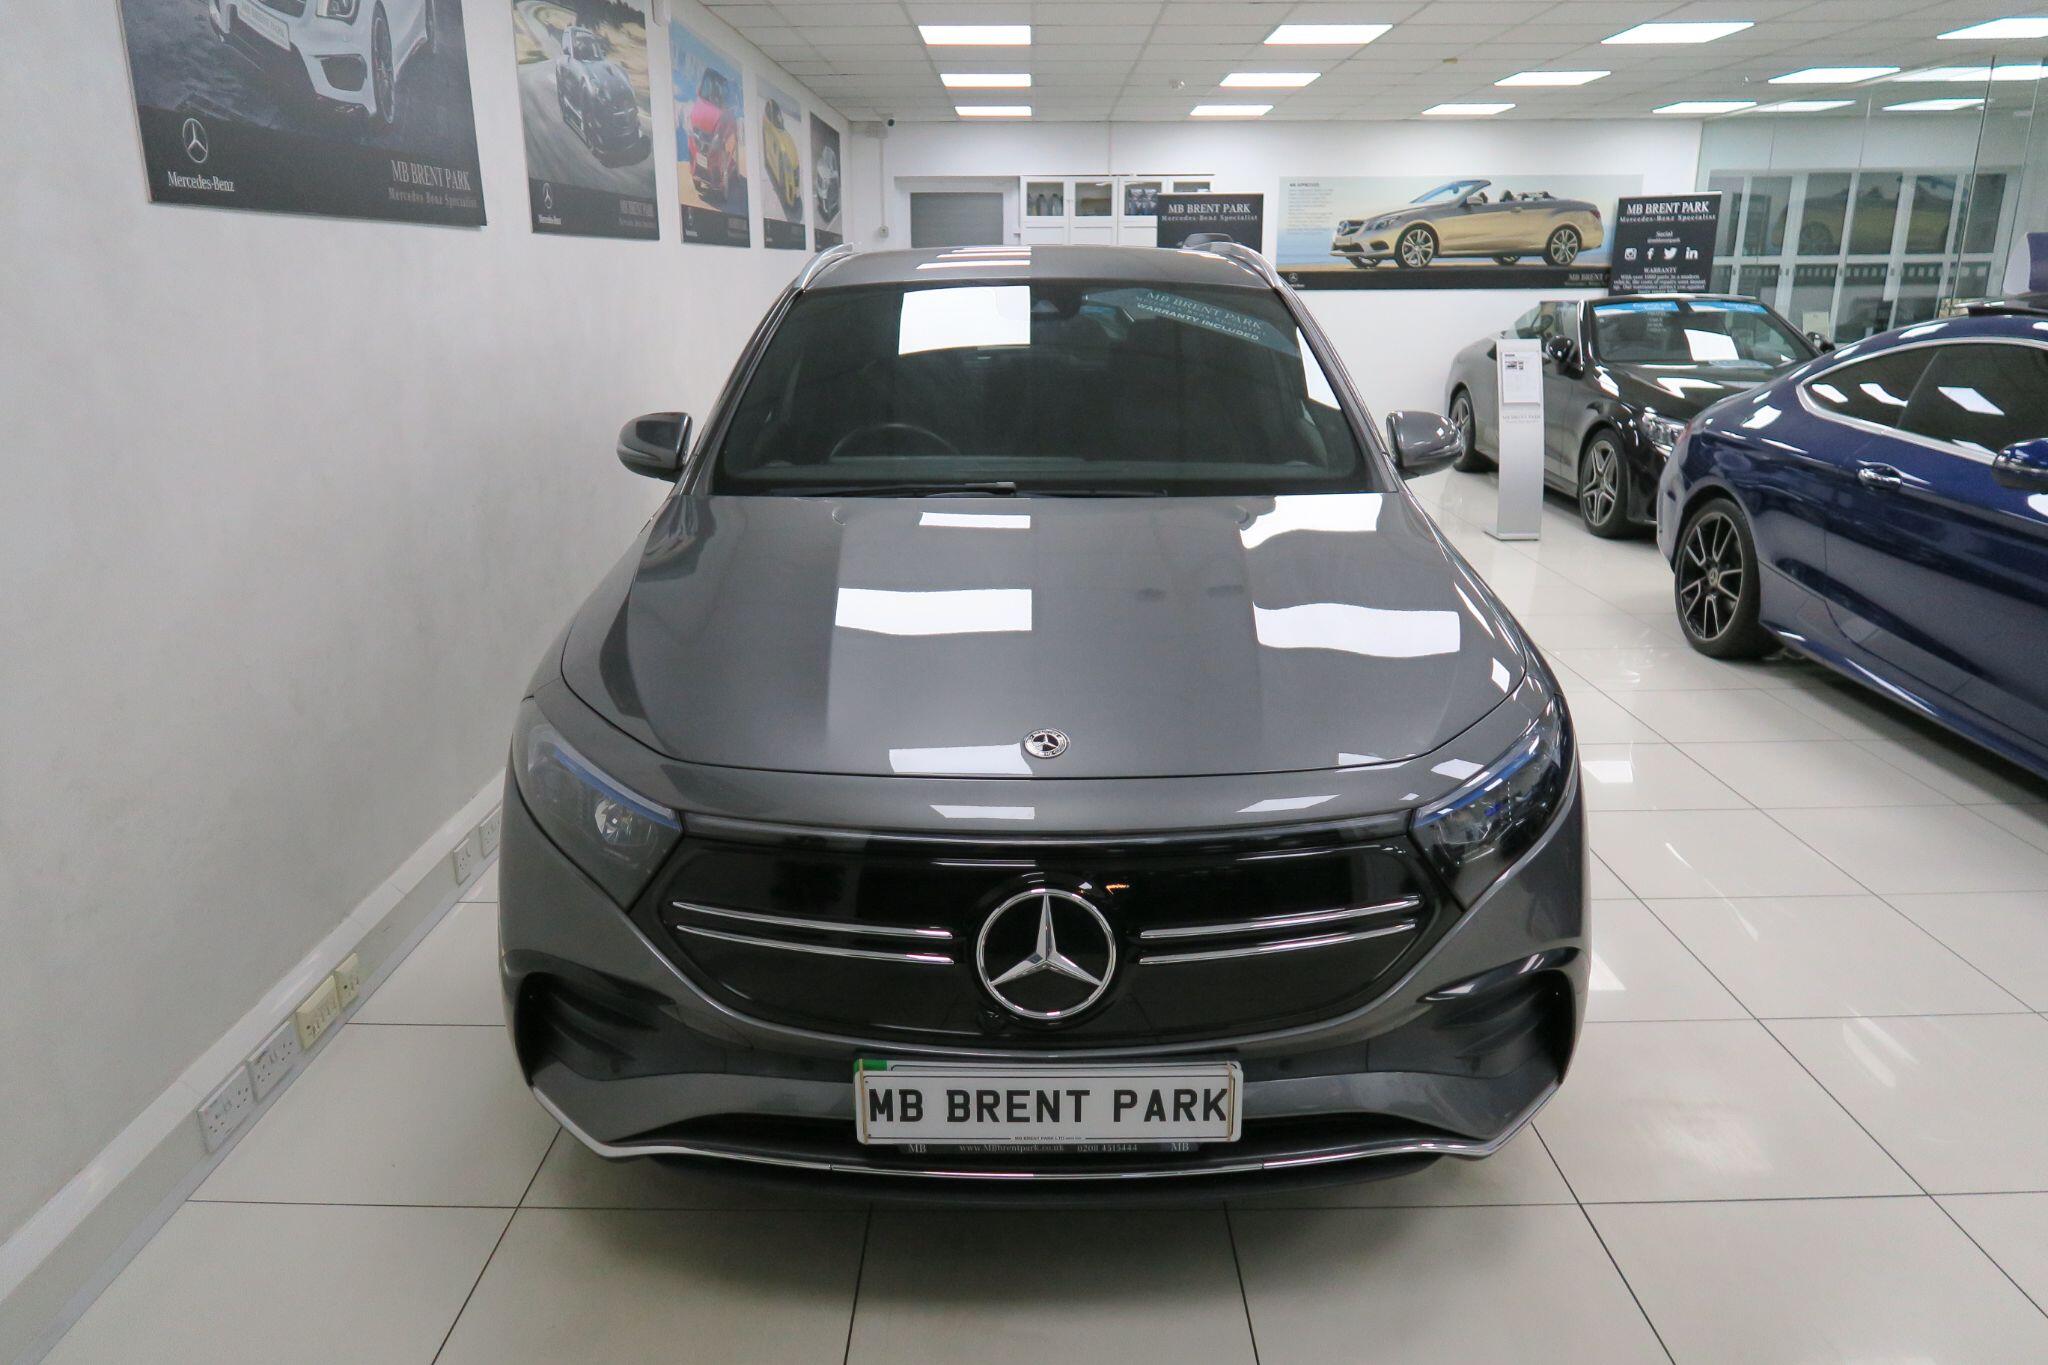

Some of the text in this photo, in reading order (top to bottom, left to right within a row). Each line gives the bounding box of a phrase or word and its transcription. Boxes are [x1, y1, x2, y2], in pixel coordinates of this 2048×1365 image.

[168, 171, 235, 192] Mercedes-Benz
[391, 160, 471, 191] MB BRENT PARK
[1168, 203, 1251, 214] MB BRENT PARK
[1626, 200, 1710, 215] MB BRENT PARK
[1678, 214, 1716, 222] Specialist
[1644, 266, 1678, 274] WARRANTY
[1147, 292, 1170, 302] MB
[1173, 299, 1219, 316] BRENT
[1224, 312, 1262, 330] PARK
[1137, 302, 1200, 322] WARRANTY
[1201, 319, 1260, 340] INCLUDED
[869, 1087, 1229, 1123] MB BRENT PARK
[908, 1143, 927, 1153] MB
[1170, 1142, 1190, 1152] MB
